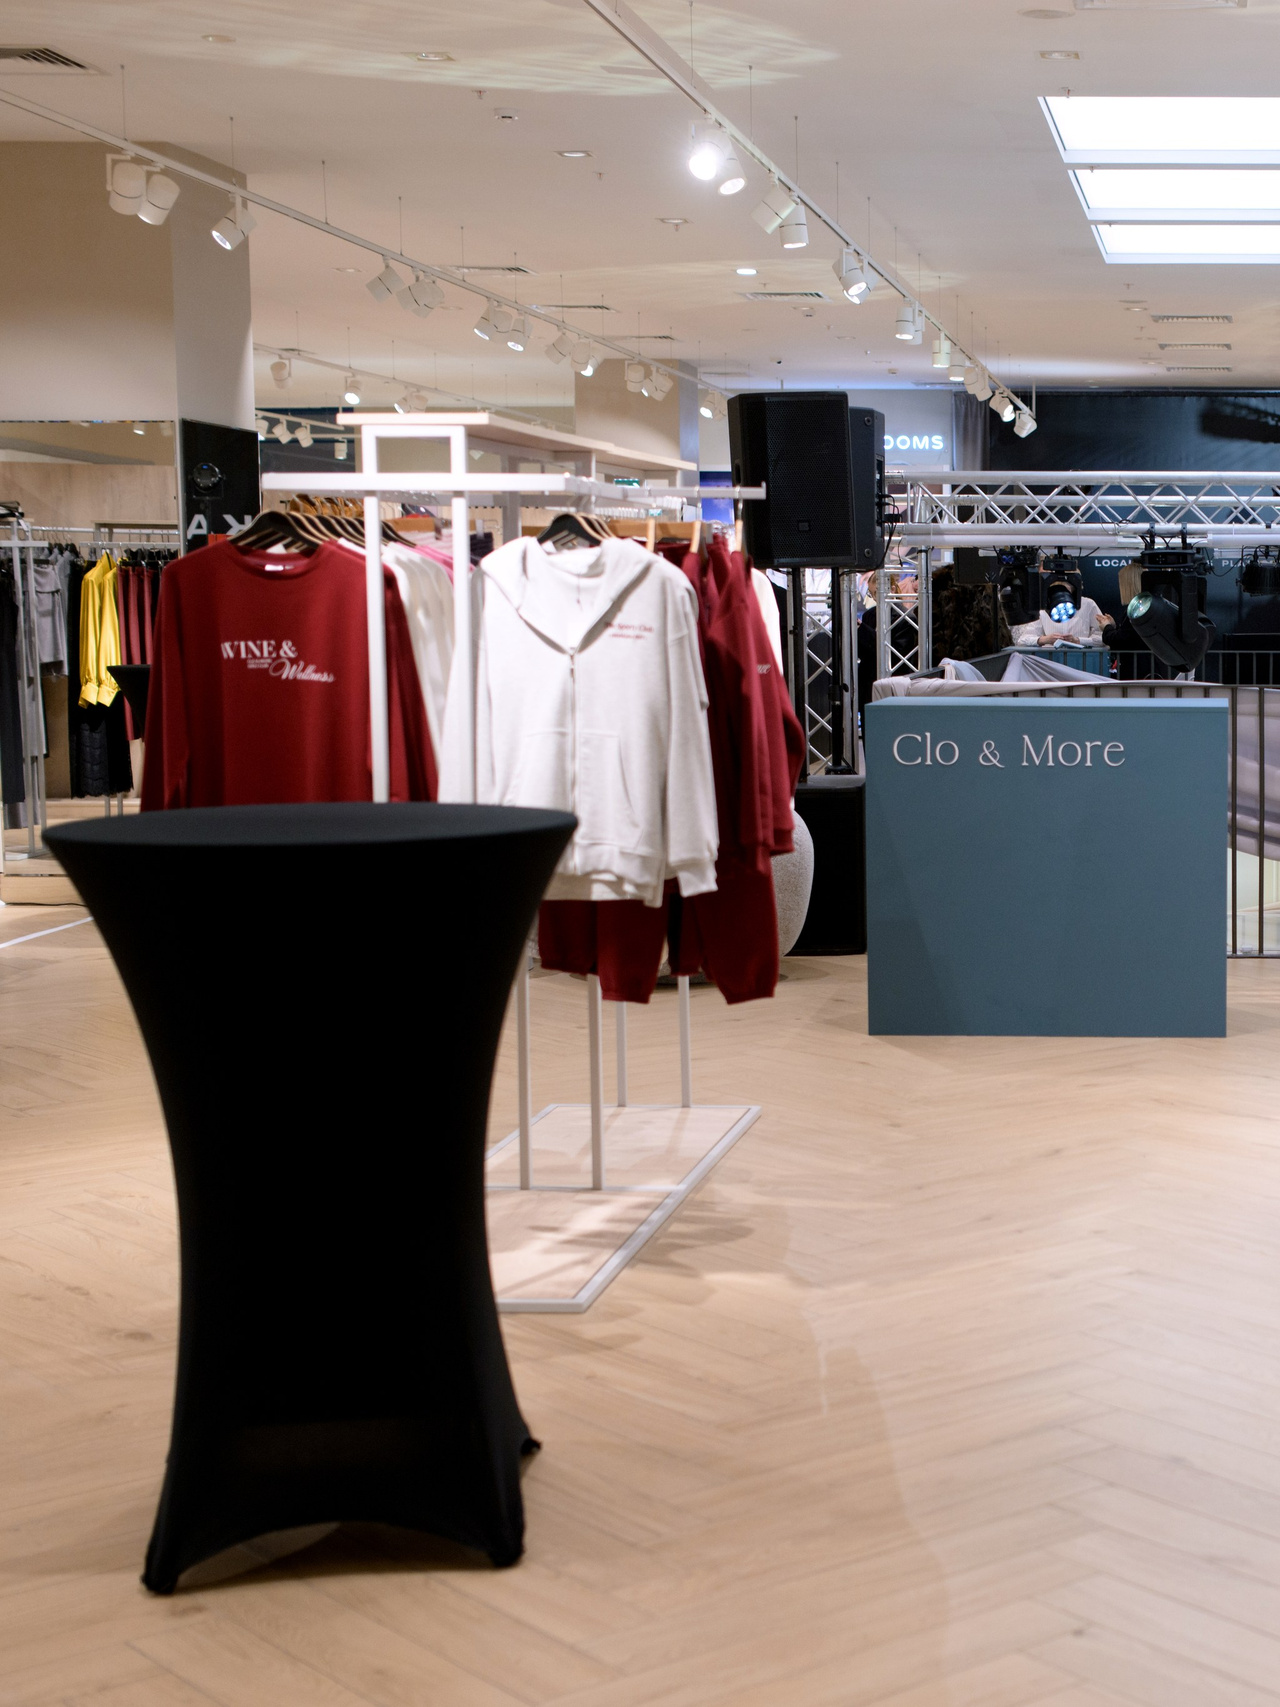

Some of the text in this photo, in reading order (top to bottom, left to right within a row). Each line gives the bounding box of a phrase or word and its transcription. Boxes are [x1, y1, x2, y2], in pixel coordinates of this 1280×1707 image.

[221, 640, 298, 659] WINE &
[893, 732, 1126, 768] Clo & More
